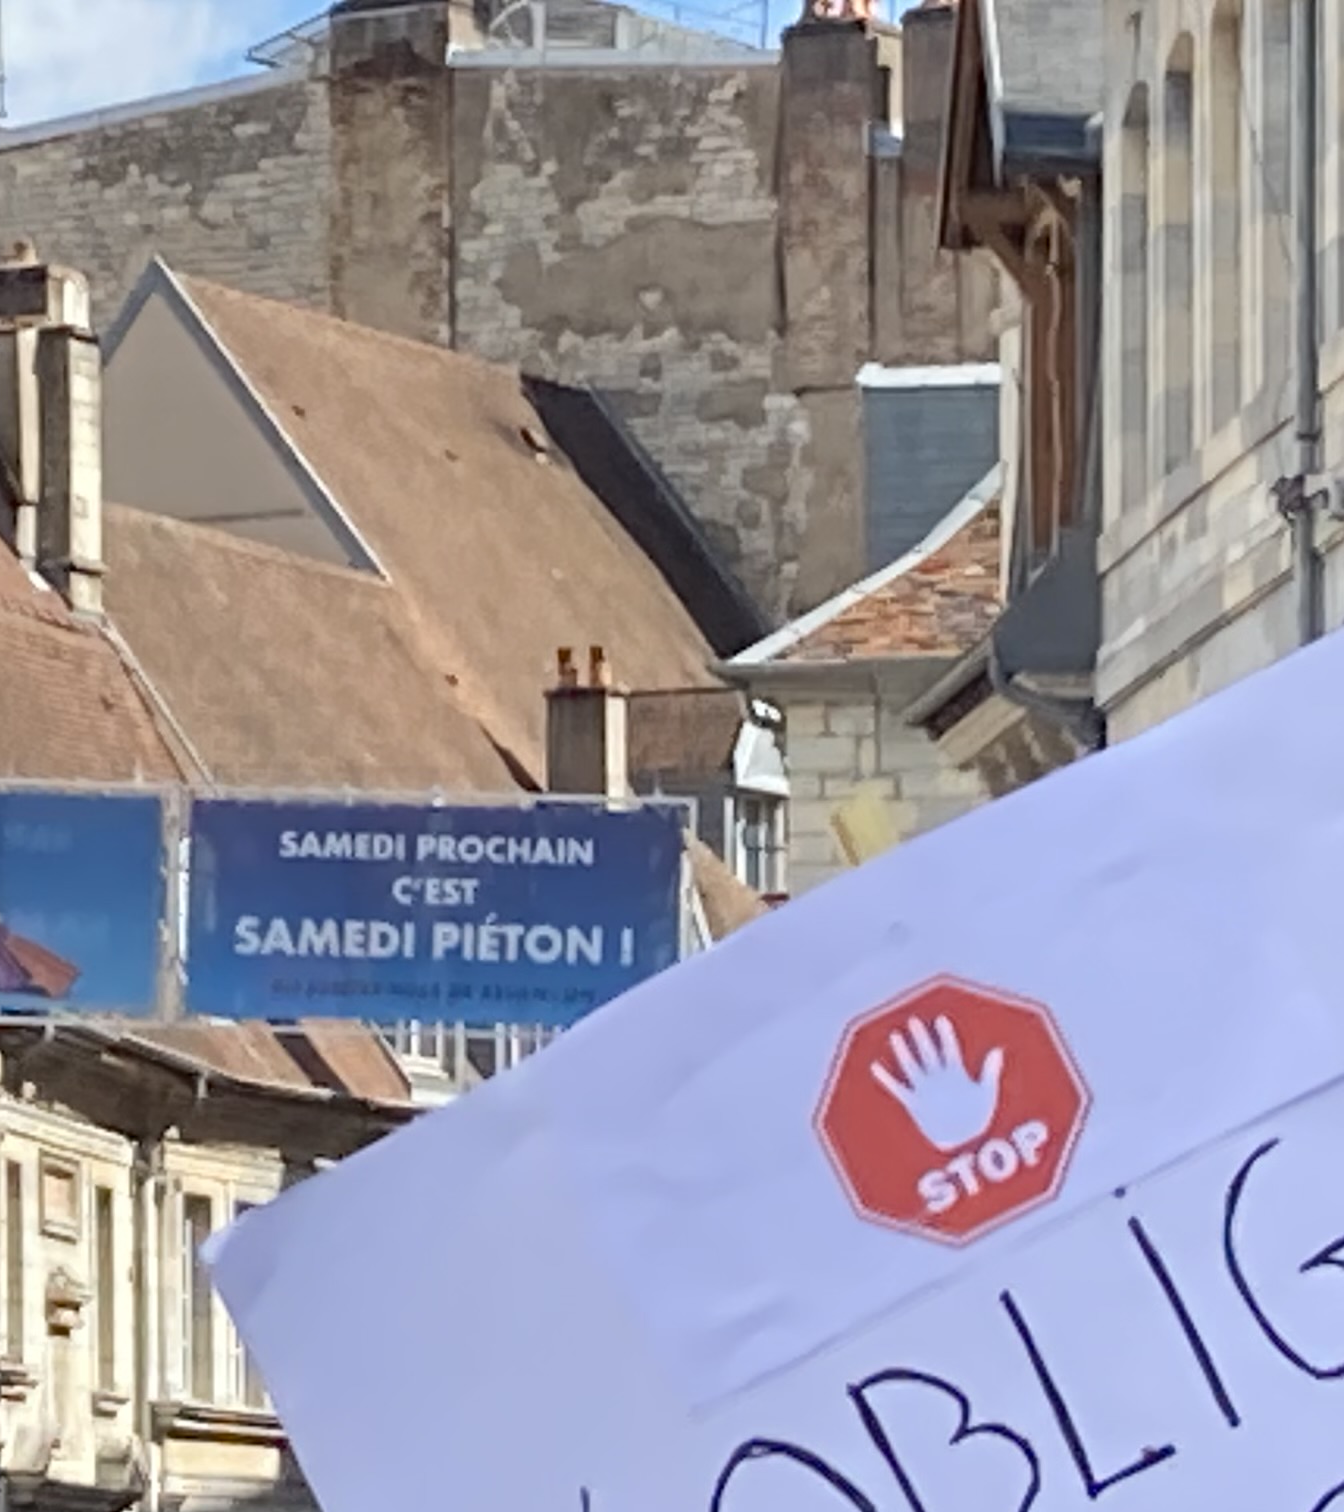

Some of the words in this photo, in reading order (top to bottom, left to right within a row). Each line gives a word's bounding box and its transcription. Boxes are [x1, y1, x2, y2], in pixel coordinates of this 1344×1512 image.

[279, 830, 405, 862] SAMEDI
[416, 832, 594, 866] PROCHAIN
[391, 876, 479, 906] C'EST
[233, 915, 416, 959] SAMEDI
[431, 912, 604, 966] PIÉTON
[916, 1119, 1050, 1214] STOP
